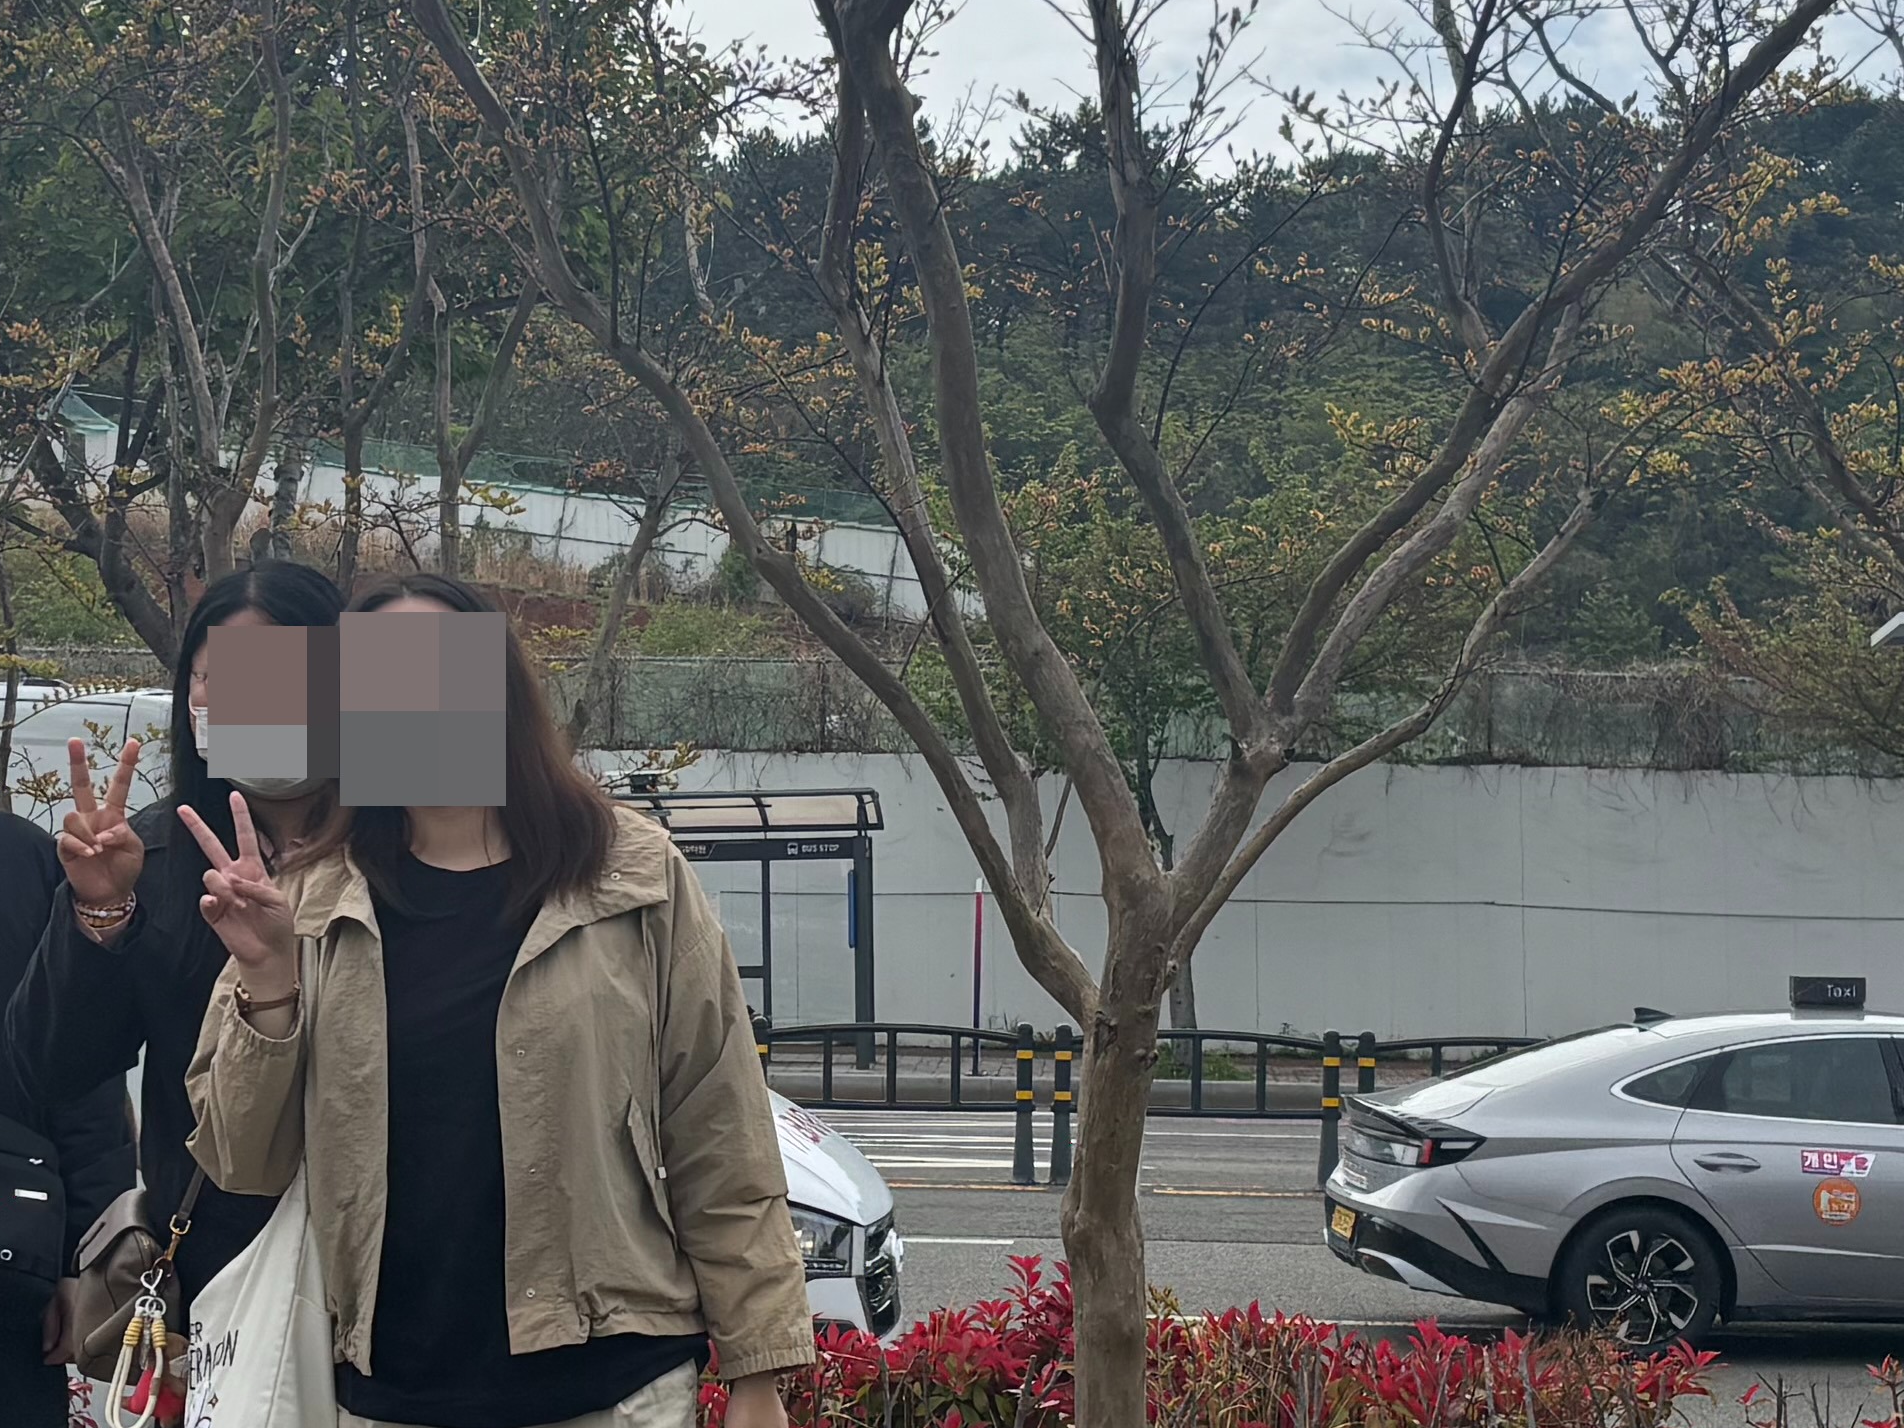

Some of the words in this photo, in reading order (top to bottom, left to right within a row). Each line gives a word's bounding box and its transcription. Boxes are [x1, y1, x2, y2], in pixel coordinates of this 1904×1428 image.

[801, 843, 817, 853] BUS
[819, 843, 839, 852] STOP
[1802, 1151, 1838, 1170] 개인
